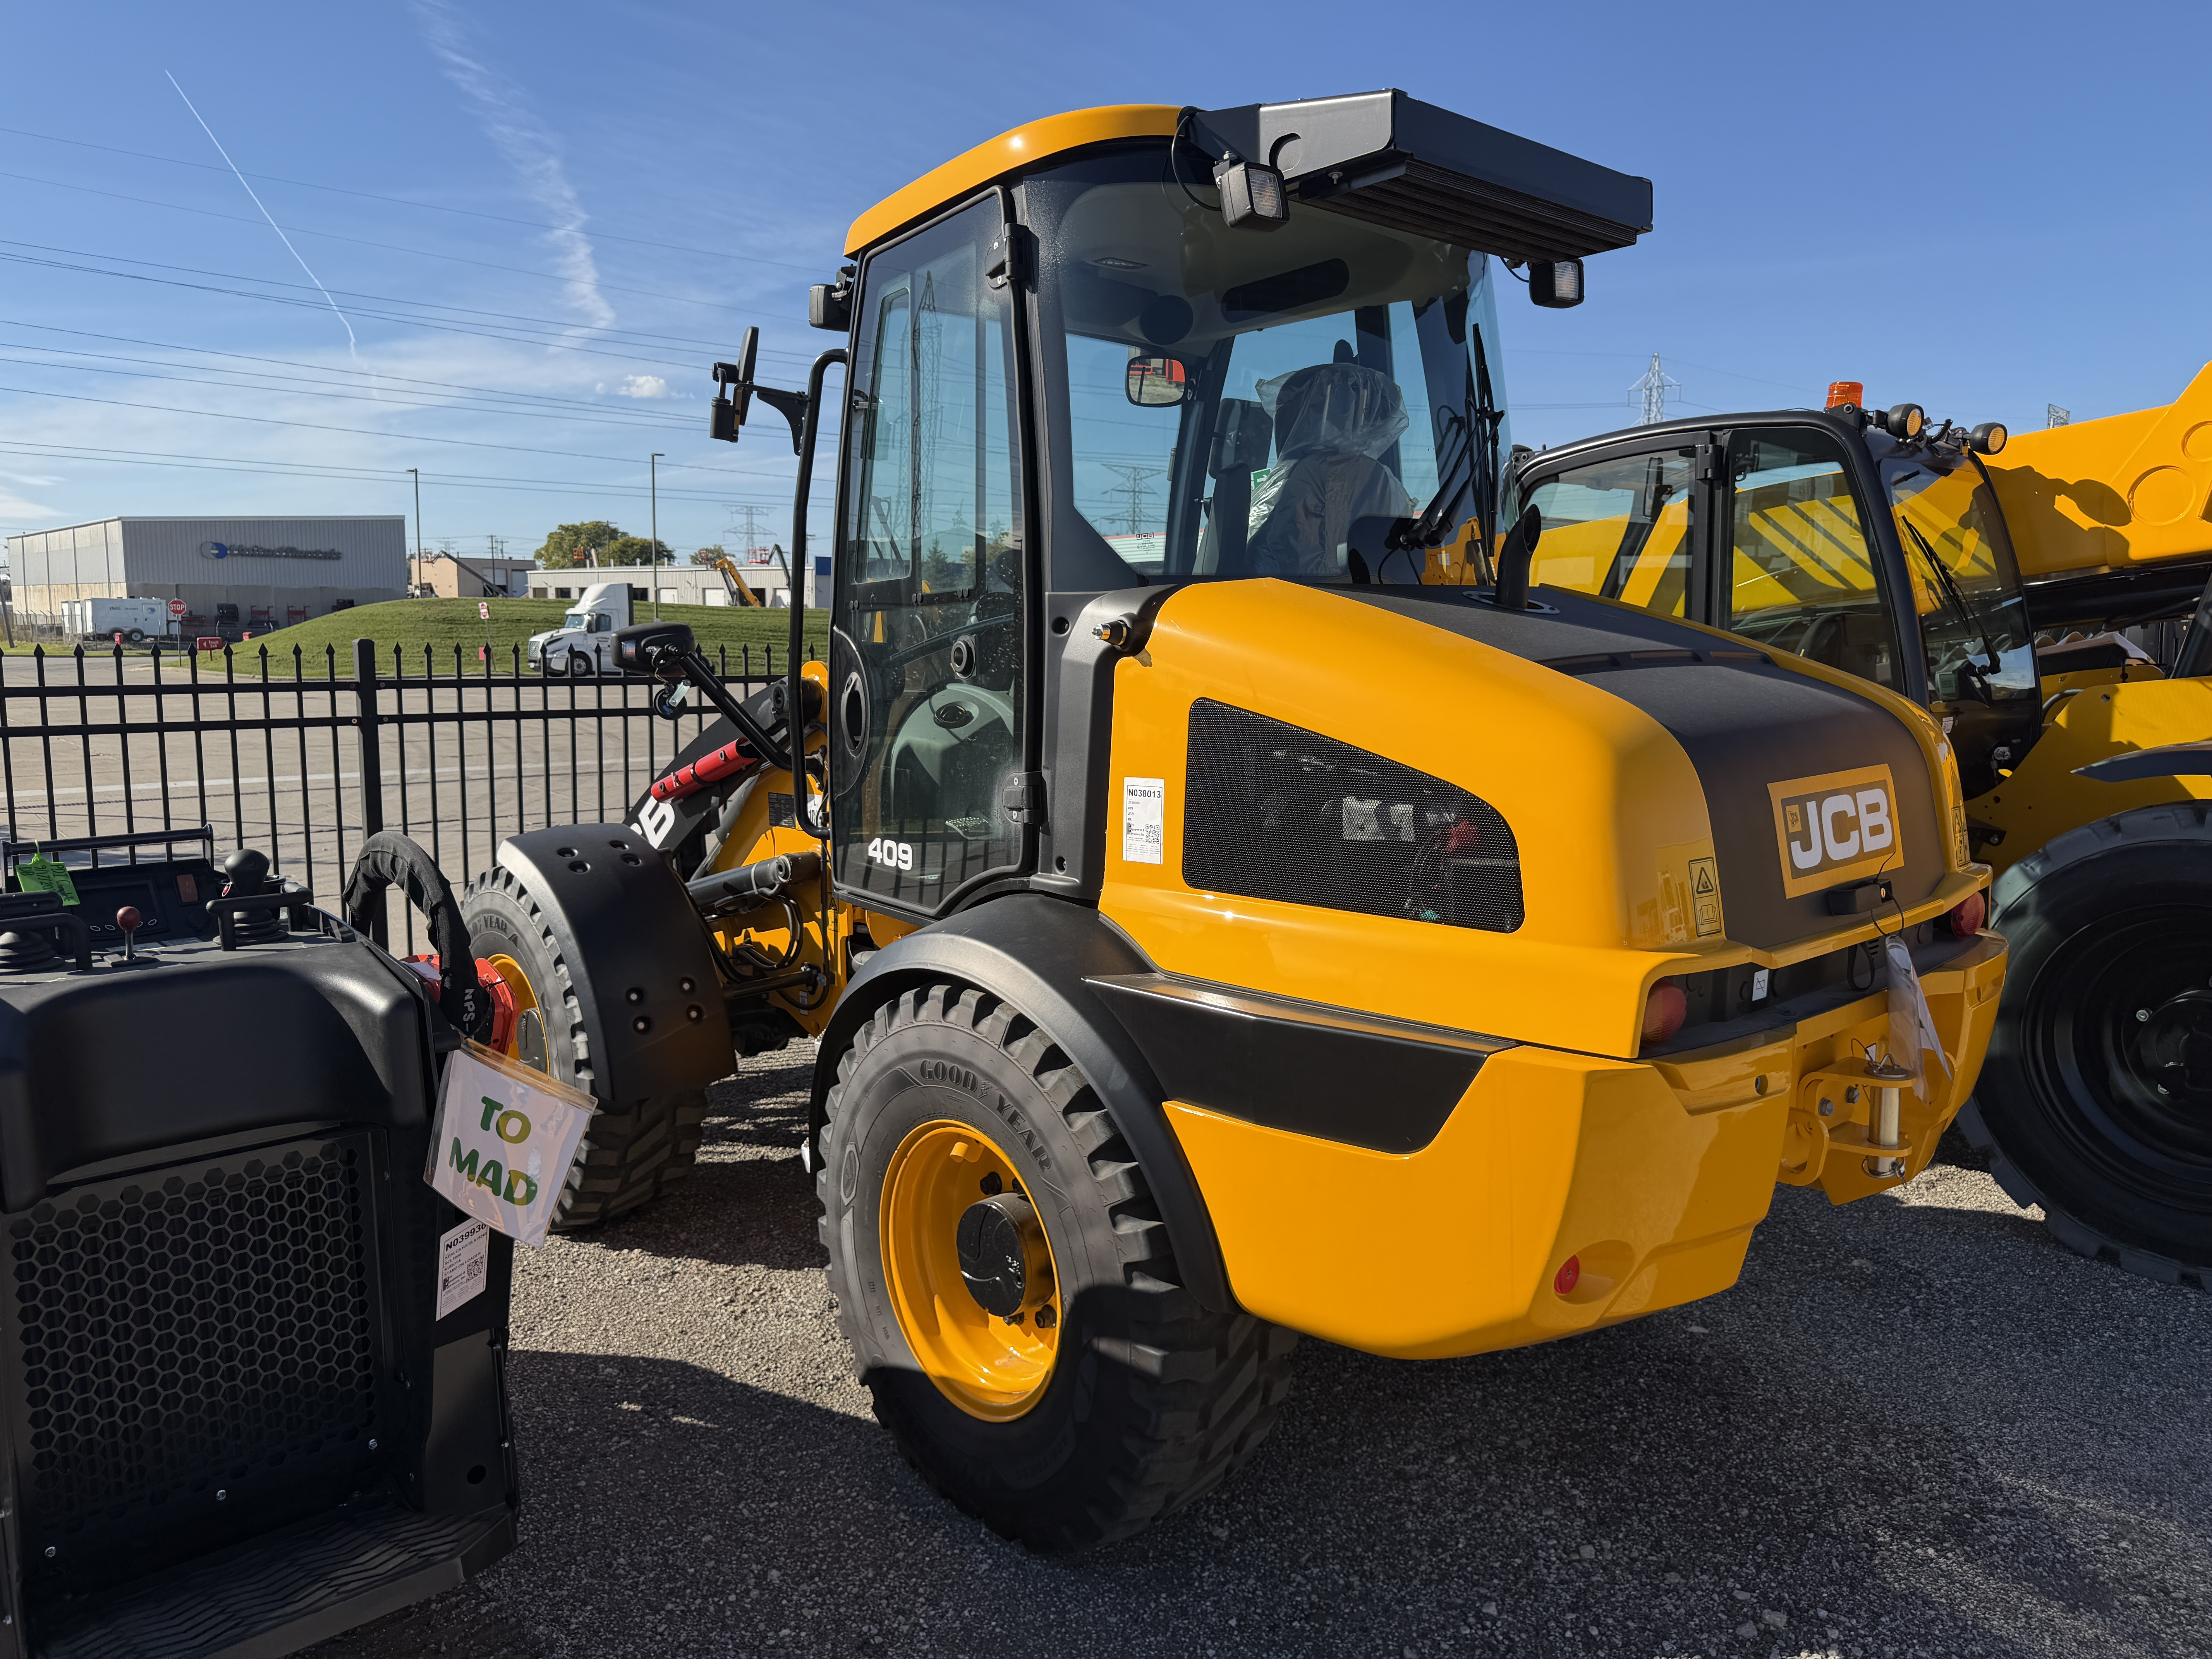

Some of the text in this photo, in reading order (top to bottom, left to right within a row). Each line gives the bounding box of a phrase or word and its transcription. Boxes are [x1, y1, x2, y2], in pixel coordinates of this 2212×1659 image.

[1128, 789, 1161, 798] N038013
[1791, 788, 1892, 869] JCB
[868, 837, 912, 871] 409
[34, 865, 55, 891] 9/17/20
[50, 864, 68, 878] PDI
[481, 1096, 531, 1144] TO
[449, 1137, 538, 1206] MAD
[444, 1266, 457, 1277] STAND
[465, 1252, 481, 1264] LOADER
[444, 1259, 461, 1271] KUBOTA
